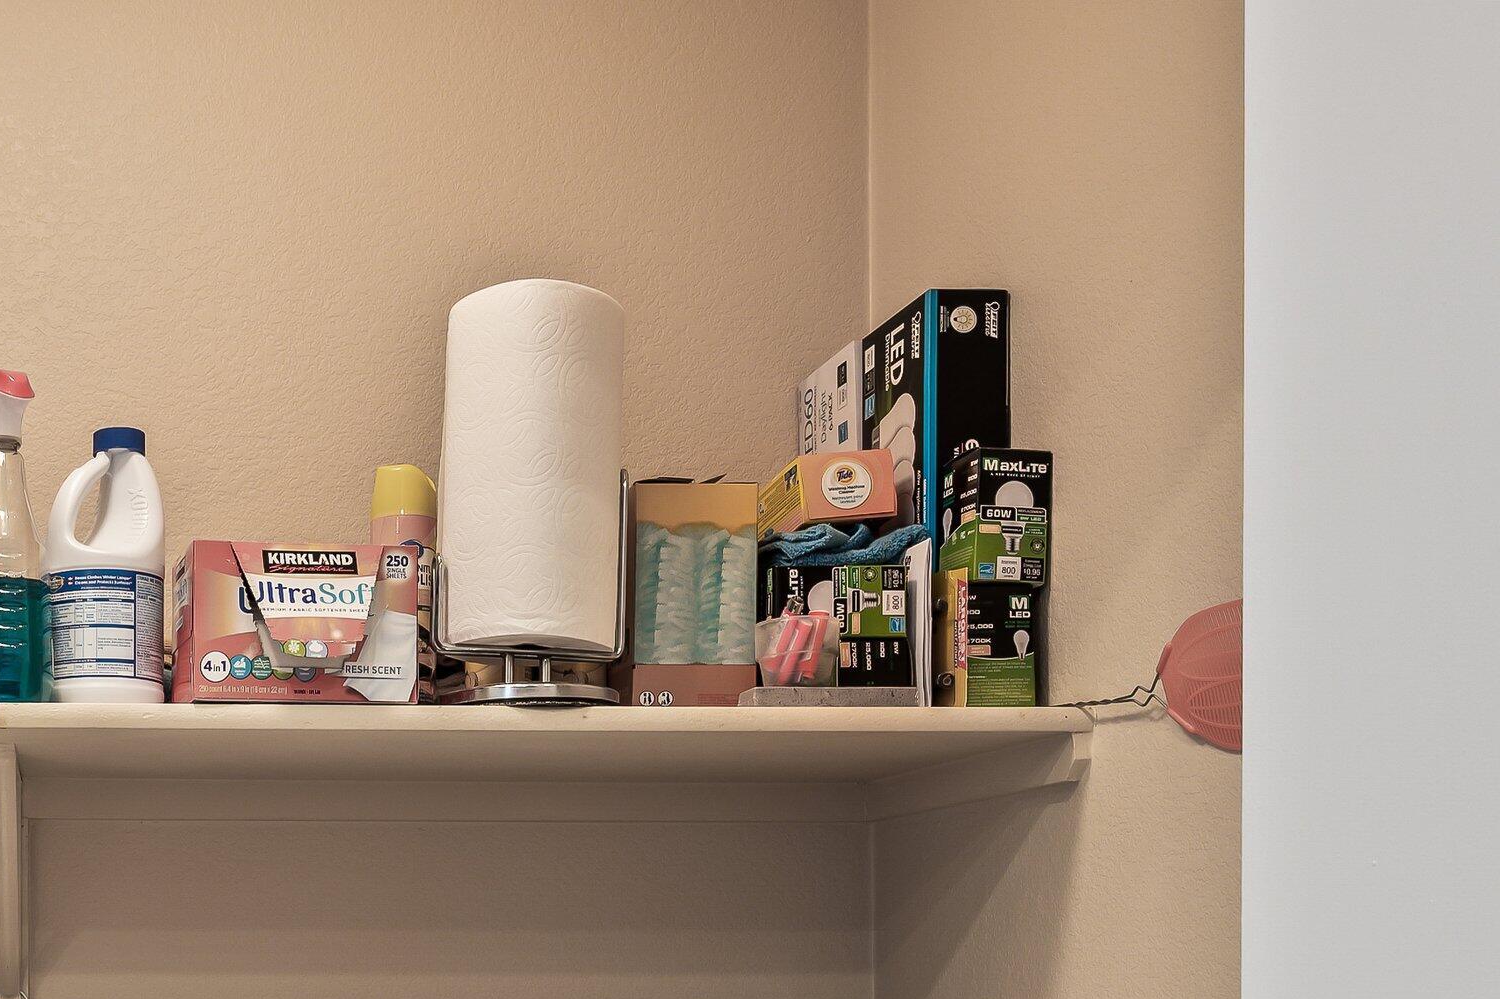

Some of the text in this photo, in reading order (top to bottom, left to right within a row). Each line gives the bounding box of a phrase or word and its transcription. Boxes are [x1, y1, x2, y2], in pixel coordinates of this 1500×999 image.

[890, 323, 905, 386] LED
[804, 388, 814, 455] ED60
[836, 470, 853, 482] Tide
[944, 474, 953, 489] M
[986, 508, 1012, 518] 60W
[267, 552, 354, 566] KIRKLAND
[386, 555, 409, 567] 250
[1001, 567, 1016, 575] 800
[892, 595, 900, 611] 800
[1011, 597, 1028, 610] M
[1009, 610, 1031, 619] LED
[343, 664, 402, 675] RESH SCENT
